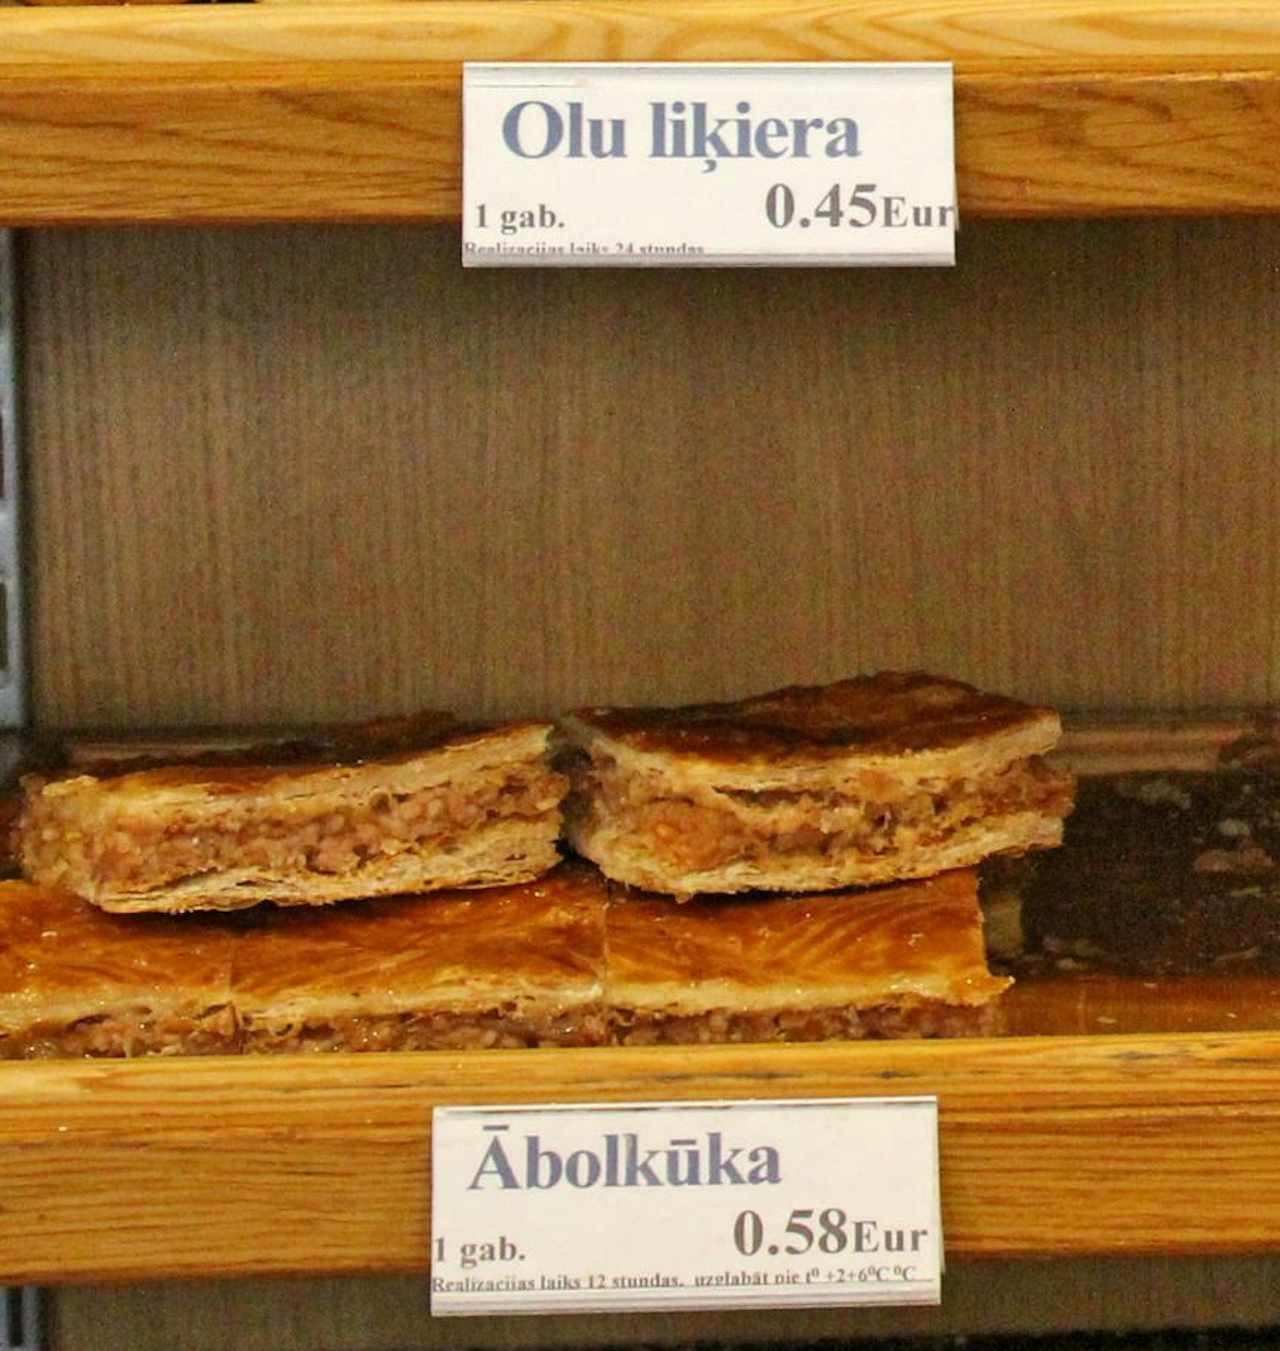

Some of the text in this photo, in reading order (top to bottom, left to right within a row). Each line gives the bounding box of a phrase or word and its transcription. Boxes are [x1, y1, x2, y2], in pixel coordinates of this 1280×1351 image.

[501, 100, 861, 173] Olu liķiera
[476, 204, 565, 234] 1 gab.
[467, 1124, 782, 1192] Ābolkūka
[433, 1236, 526, 1268] 1 gab.
